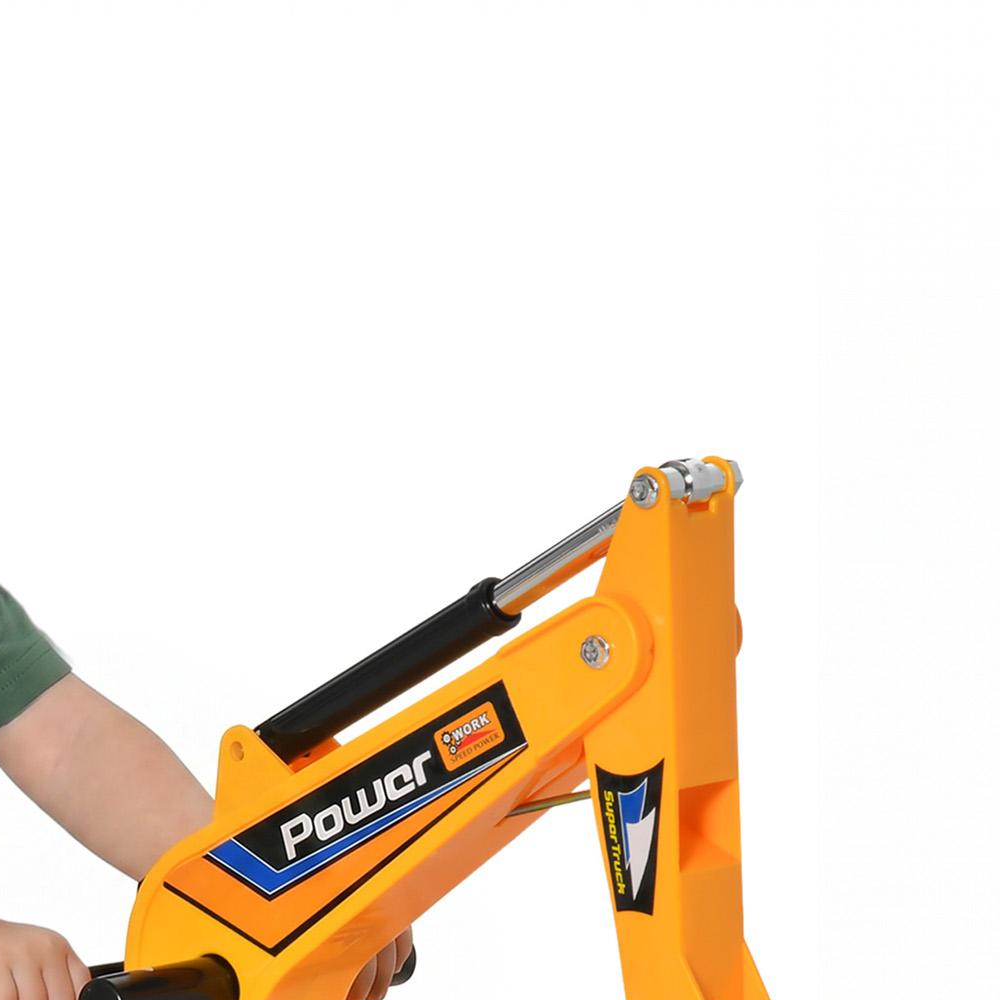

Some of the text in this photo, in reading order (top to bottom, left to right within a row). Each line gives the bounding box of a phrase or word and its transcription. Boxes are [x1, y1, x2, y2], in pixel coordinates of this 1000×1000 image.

[451, 712, 490, 741] WORK
[450, 731, 500, 764] SPEED POWER
[279, 750, 433, 861] Power
